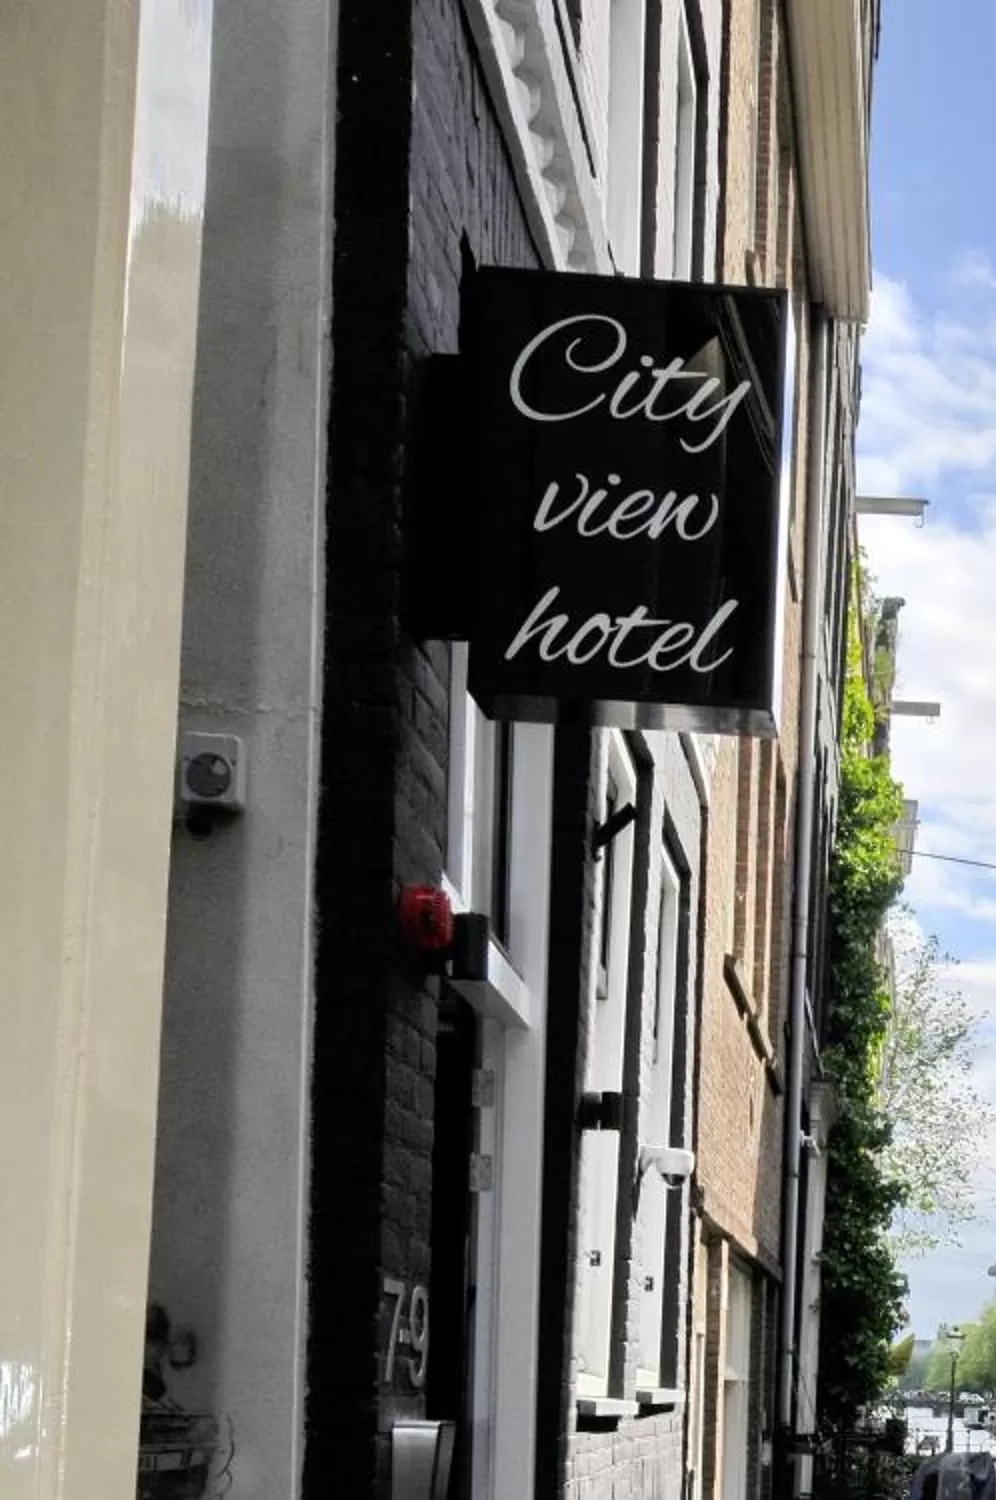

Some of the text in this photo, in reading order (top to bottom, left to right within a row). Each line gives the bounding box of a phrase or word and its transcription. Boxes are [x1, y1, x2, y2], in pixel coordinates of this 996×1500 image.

[509, 314, 752, 453] City
[533, 473, 720, 541] view
[504, 585, 740, 673] hotel
